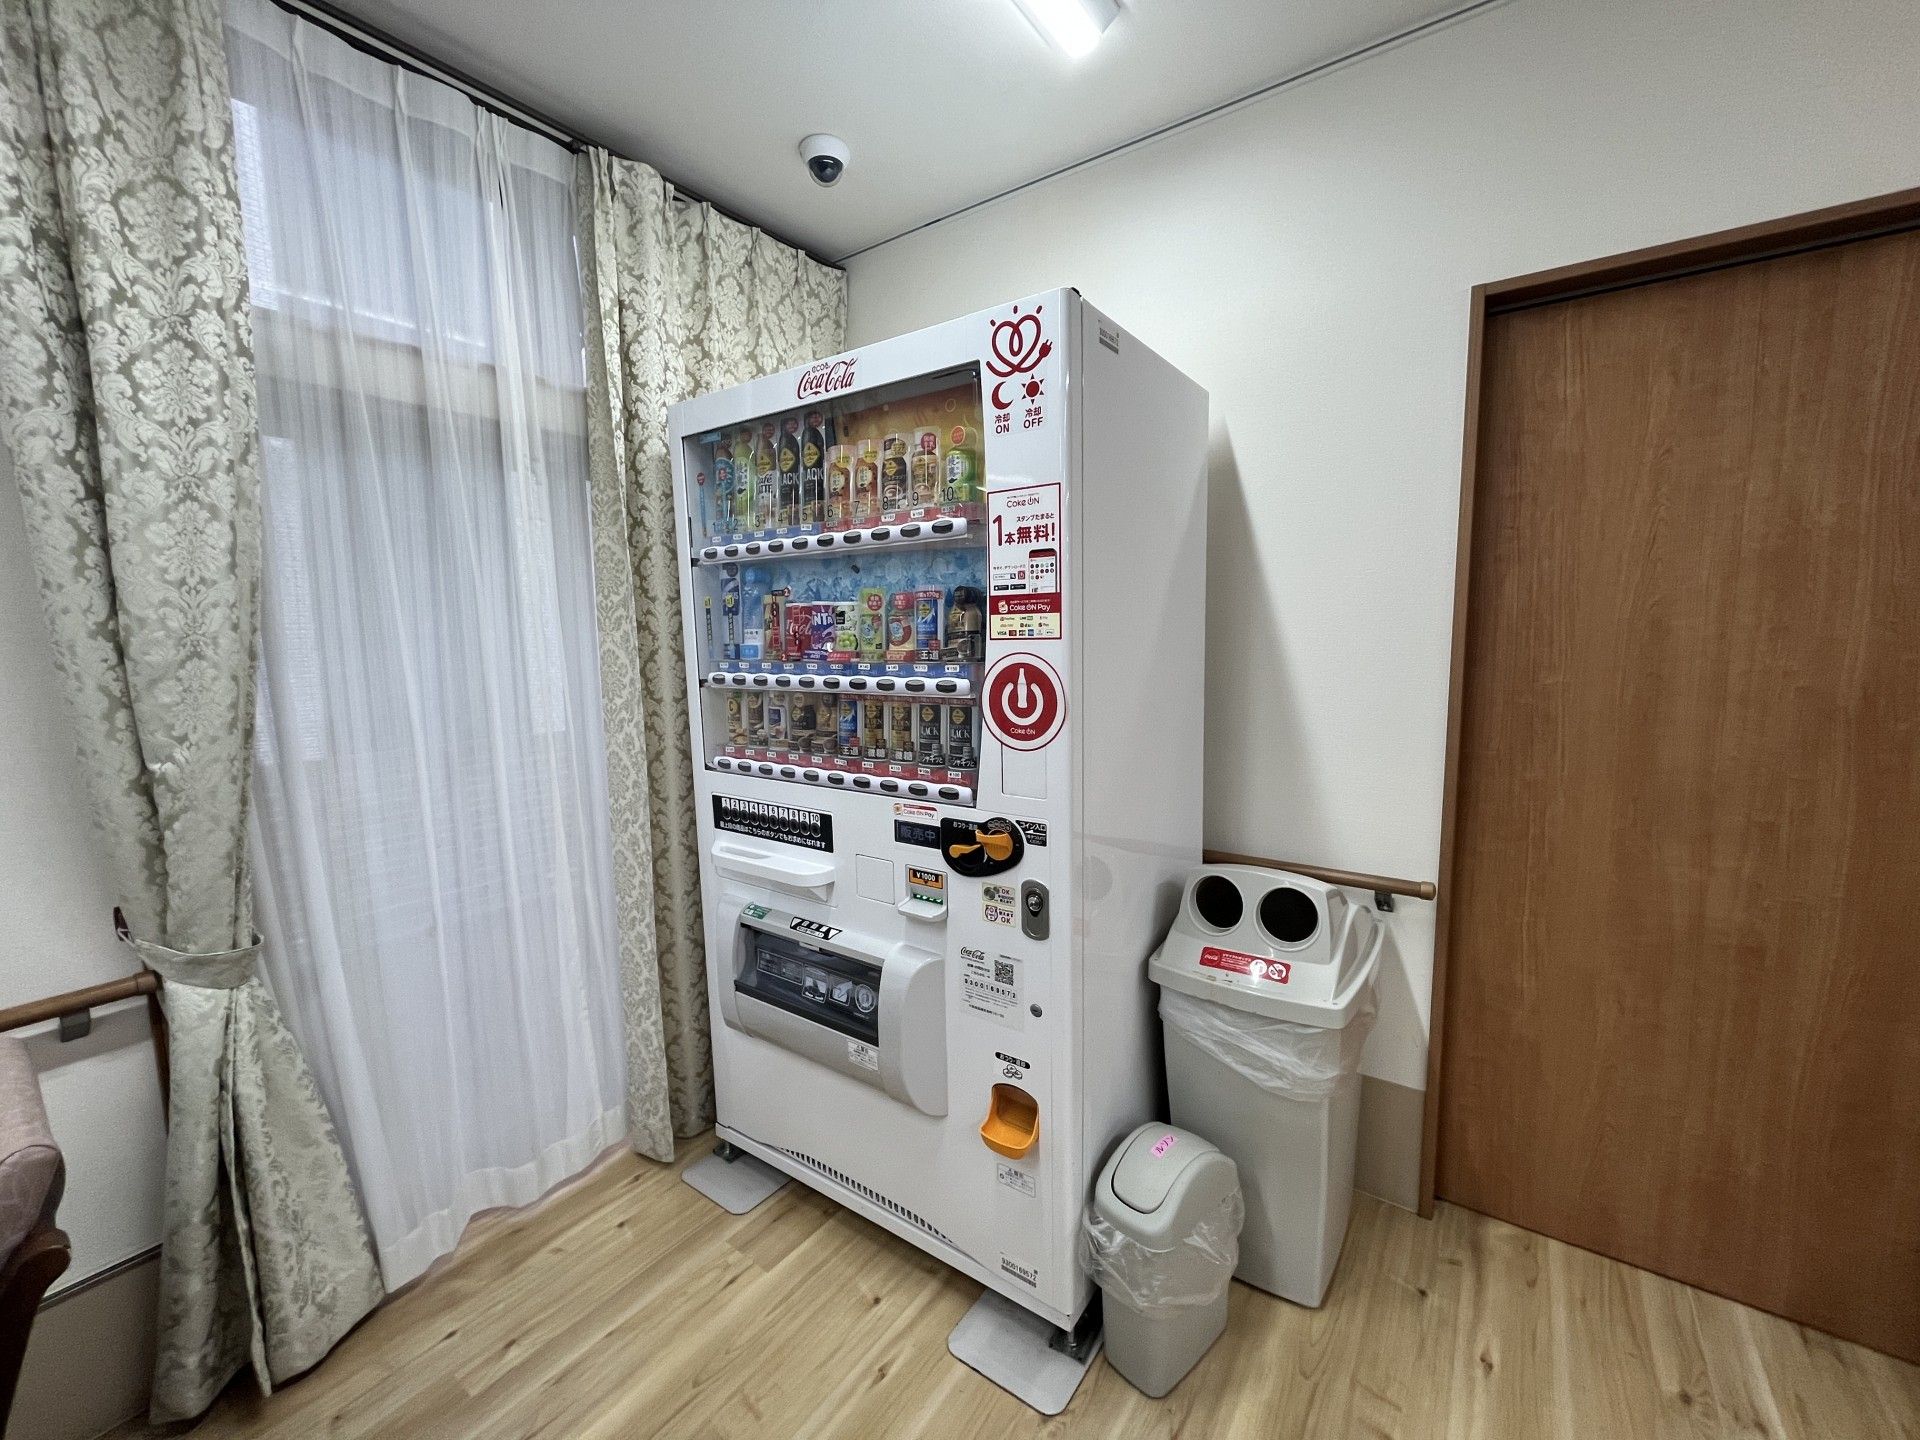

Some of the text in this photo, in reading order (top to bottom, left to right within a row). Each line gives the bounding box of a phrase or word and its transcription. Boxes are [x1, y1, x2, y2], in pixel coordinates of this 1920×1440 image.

[797, 357, 858, 400] Coca-Cola
[994, 412, 1010, 424] 冷却
[1024, 406, 1042, 419] 冷却
[1023, 416, 1044, 429] OFF
[995, 423, 1010, 434] ON
[1006, 500, 1026, 508] Coke
[1016, 512, 1055, 522] スタンプたまると
[1037, 603, 1051, 613] Pay
[1019, 821, 1047, 832] コイン入口
[900, 824, 936, 842] 販売中
[1001, 888, 1010, 896] OK
[1001, 916, 1011, 925] OK
[960, 946, 985, 961] Coca-Cola
